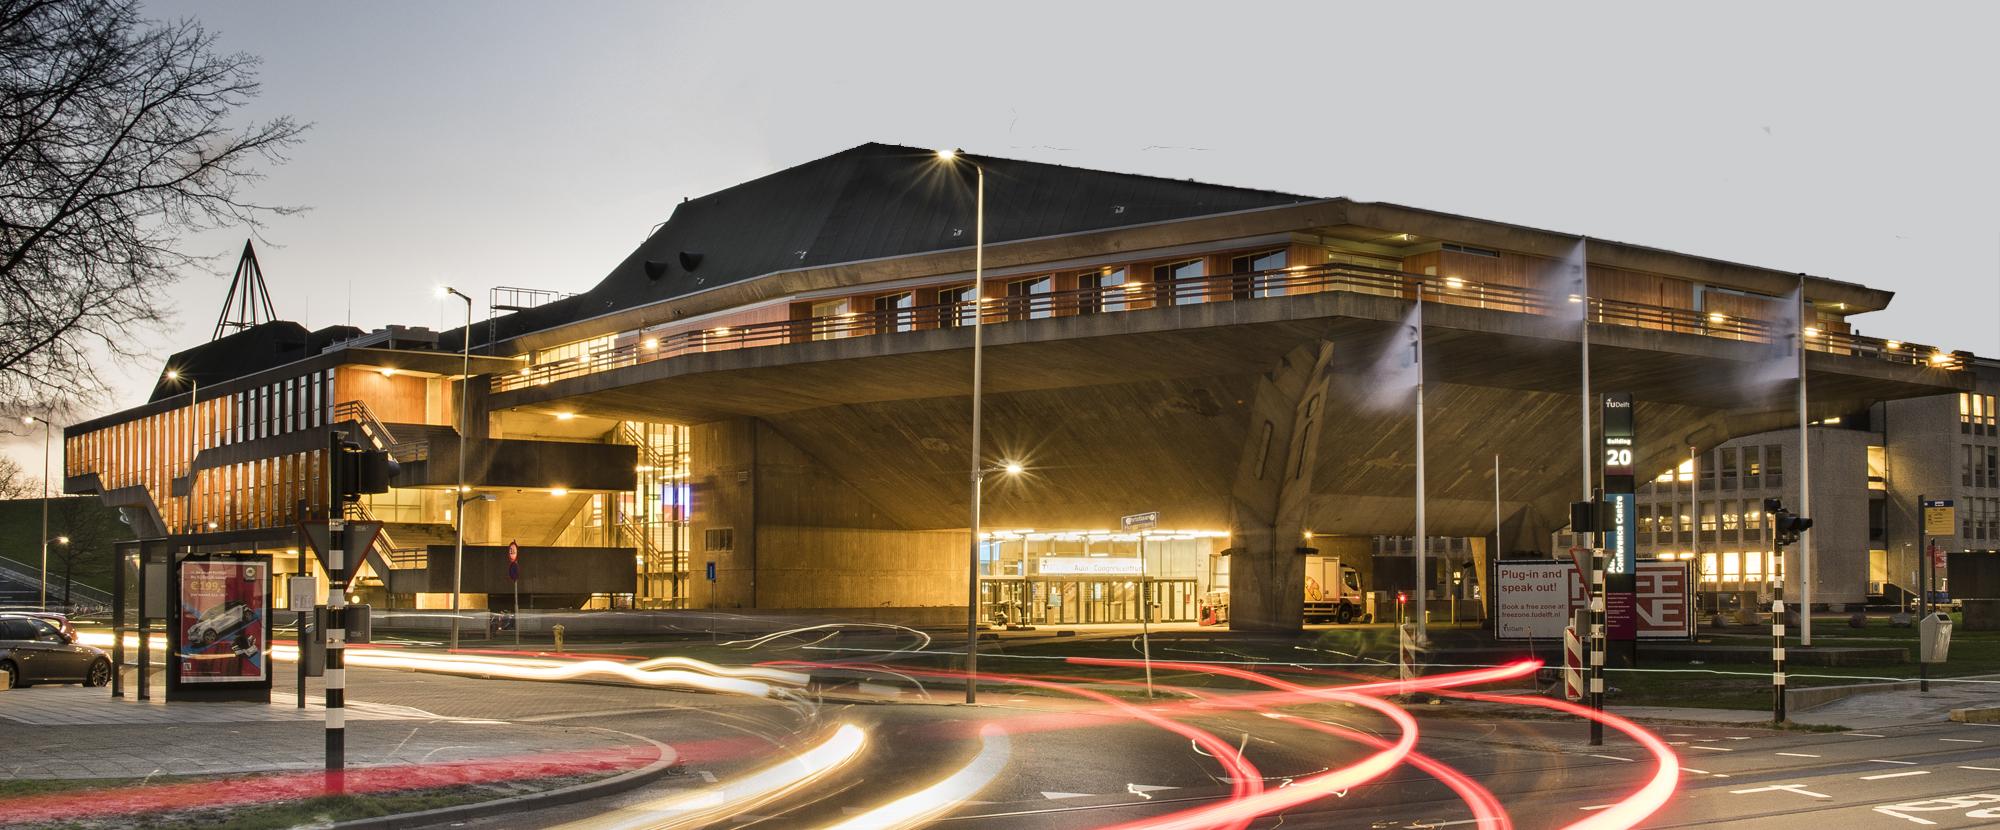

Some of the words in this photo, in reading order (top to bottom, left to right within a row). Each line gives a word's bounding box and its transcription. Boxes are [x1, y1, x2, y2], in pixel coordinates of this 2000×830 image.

[1606, 438, 1632, 446] Building
[1606, 449, 1632, 466] 20
[1615, 495, 1624, 524] Centre
[1616, 525, 1624, 573] Conference
[1501, 569, 1539, 580] Plug-in
[1542, 569, 1562, 579] and
[1502, 583, 1533, 594] speak
[1536, 583, 1557, 592] out!
